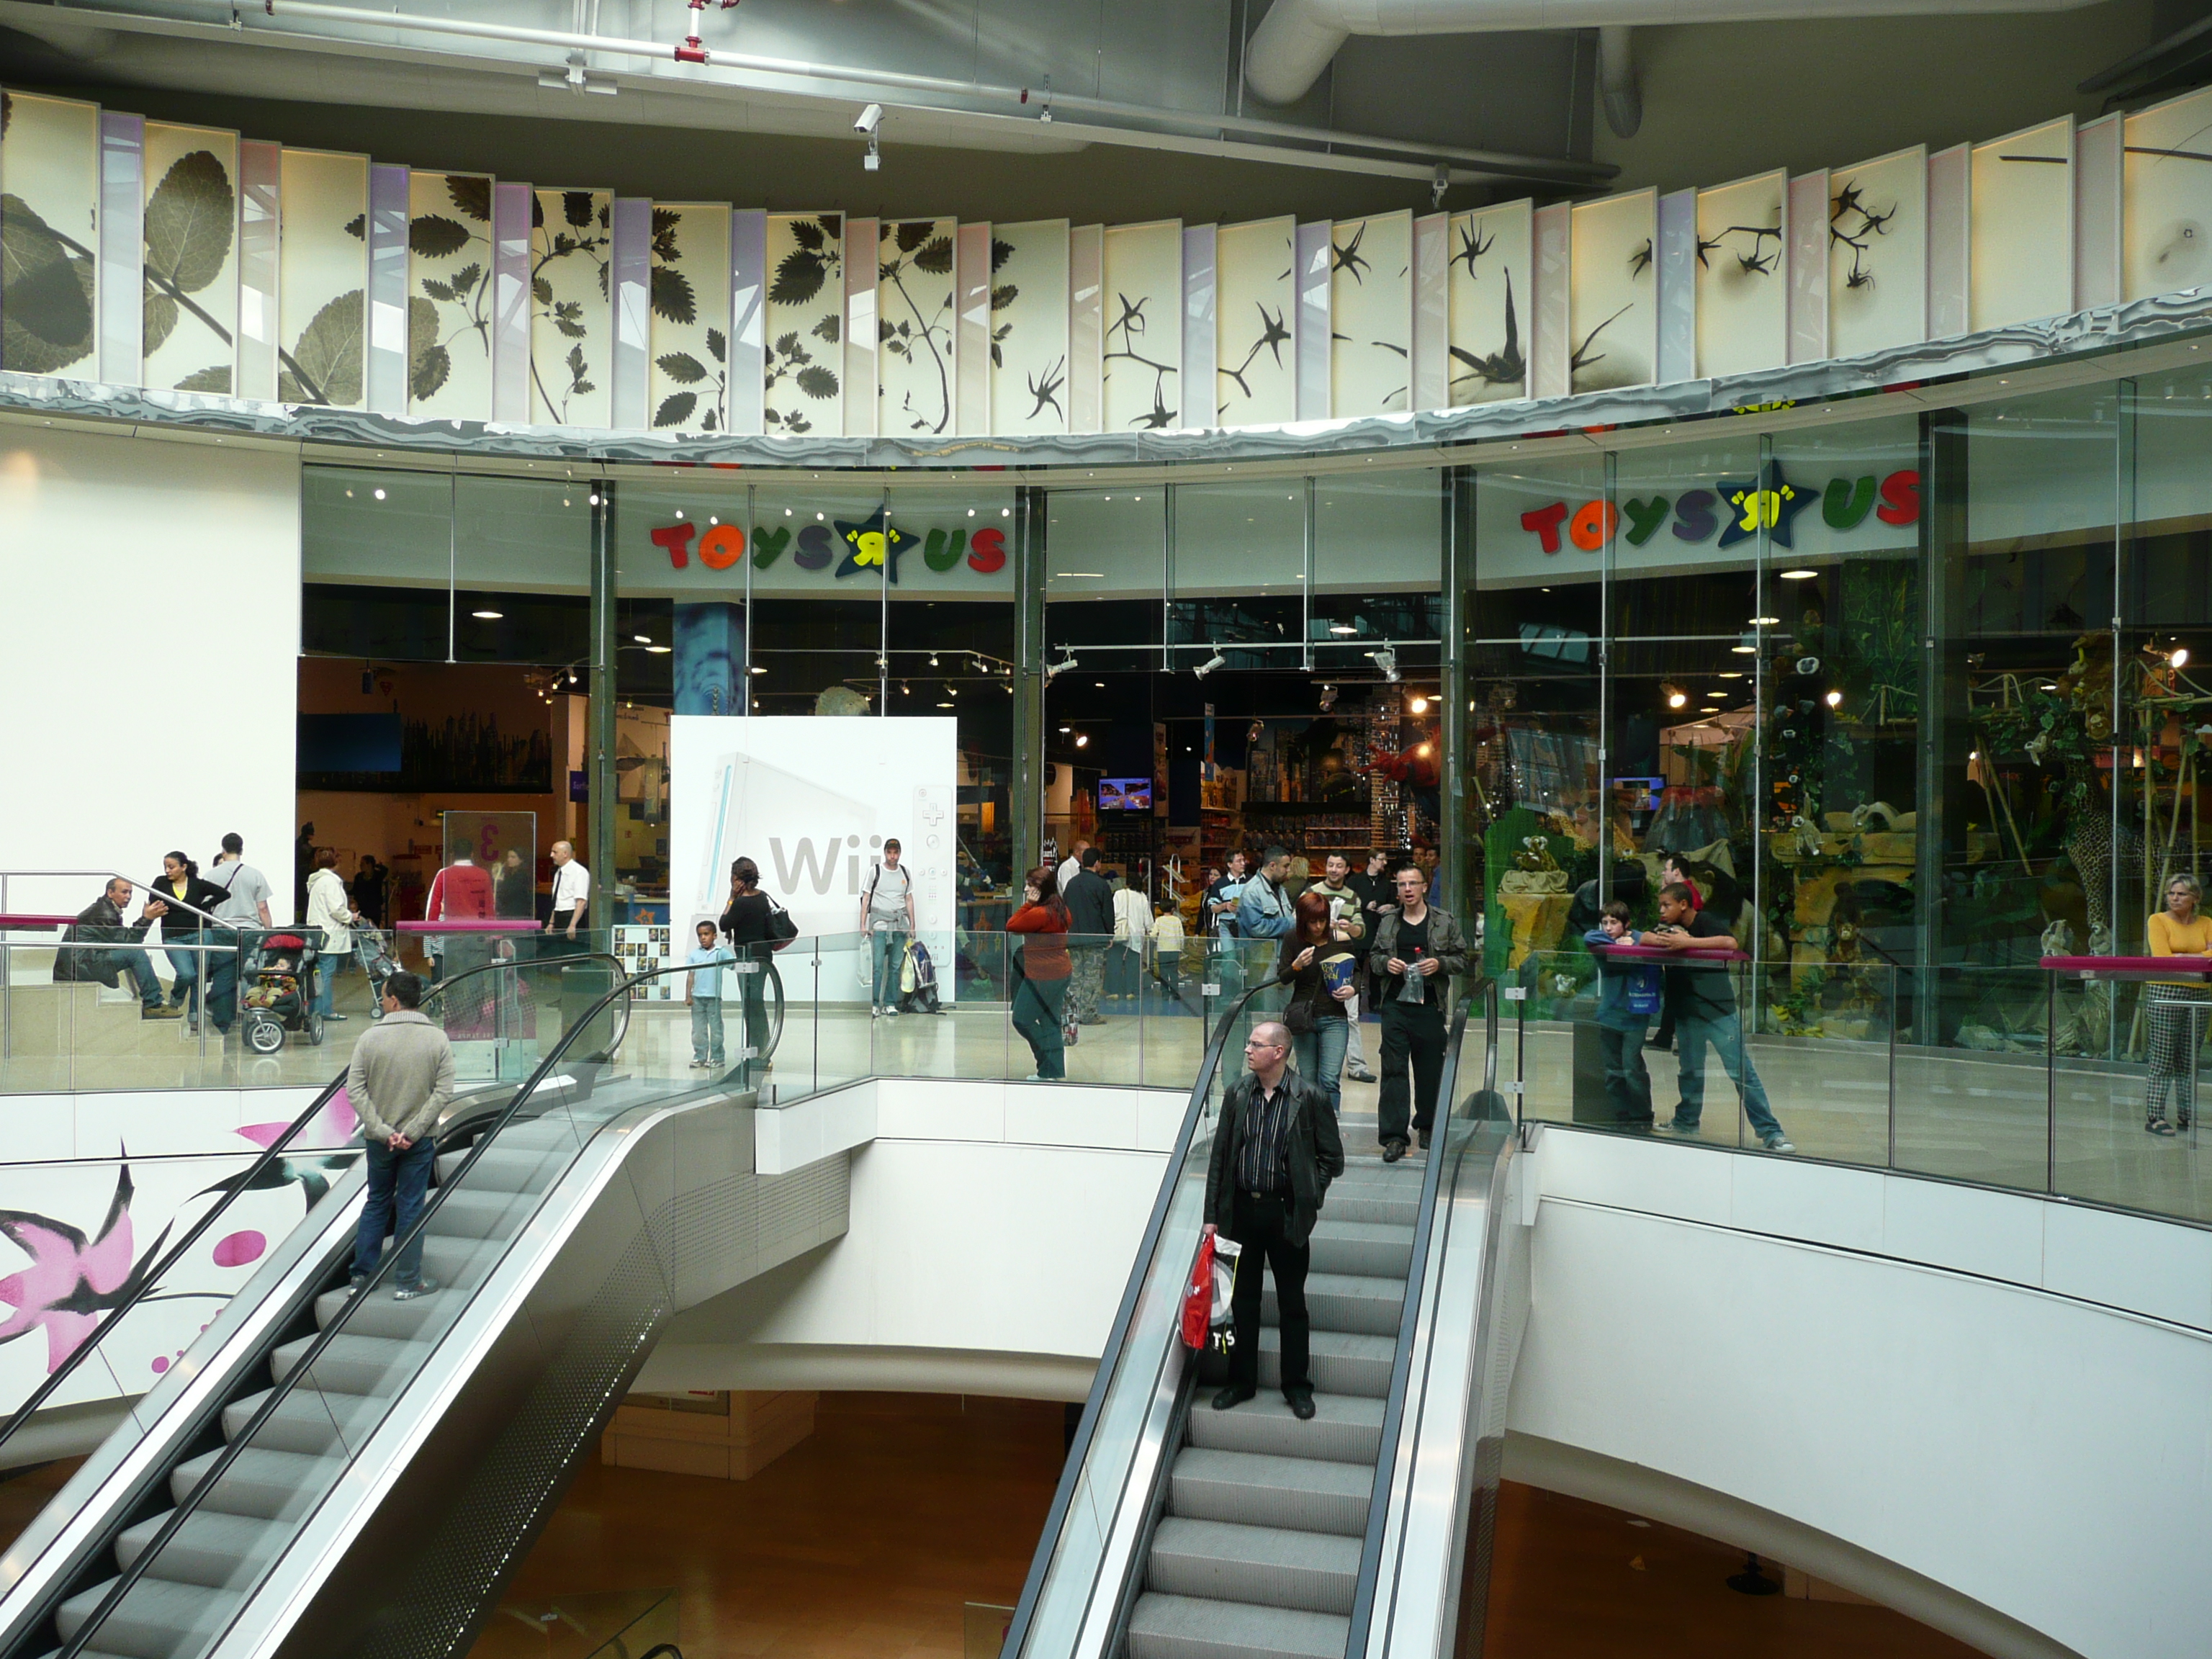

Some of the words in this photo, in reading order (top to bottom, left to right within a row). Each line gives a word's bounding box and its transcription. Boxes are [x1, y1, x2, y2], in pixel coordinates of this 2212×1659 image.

[1521, 490, 1717, 554] TOYS
[1822, 469, 1920, 531] US
[651, 521, 833, 570] TOYS
[924, 527, 1006, 573] US
[768, 834, 882, 895] Wii
